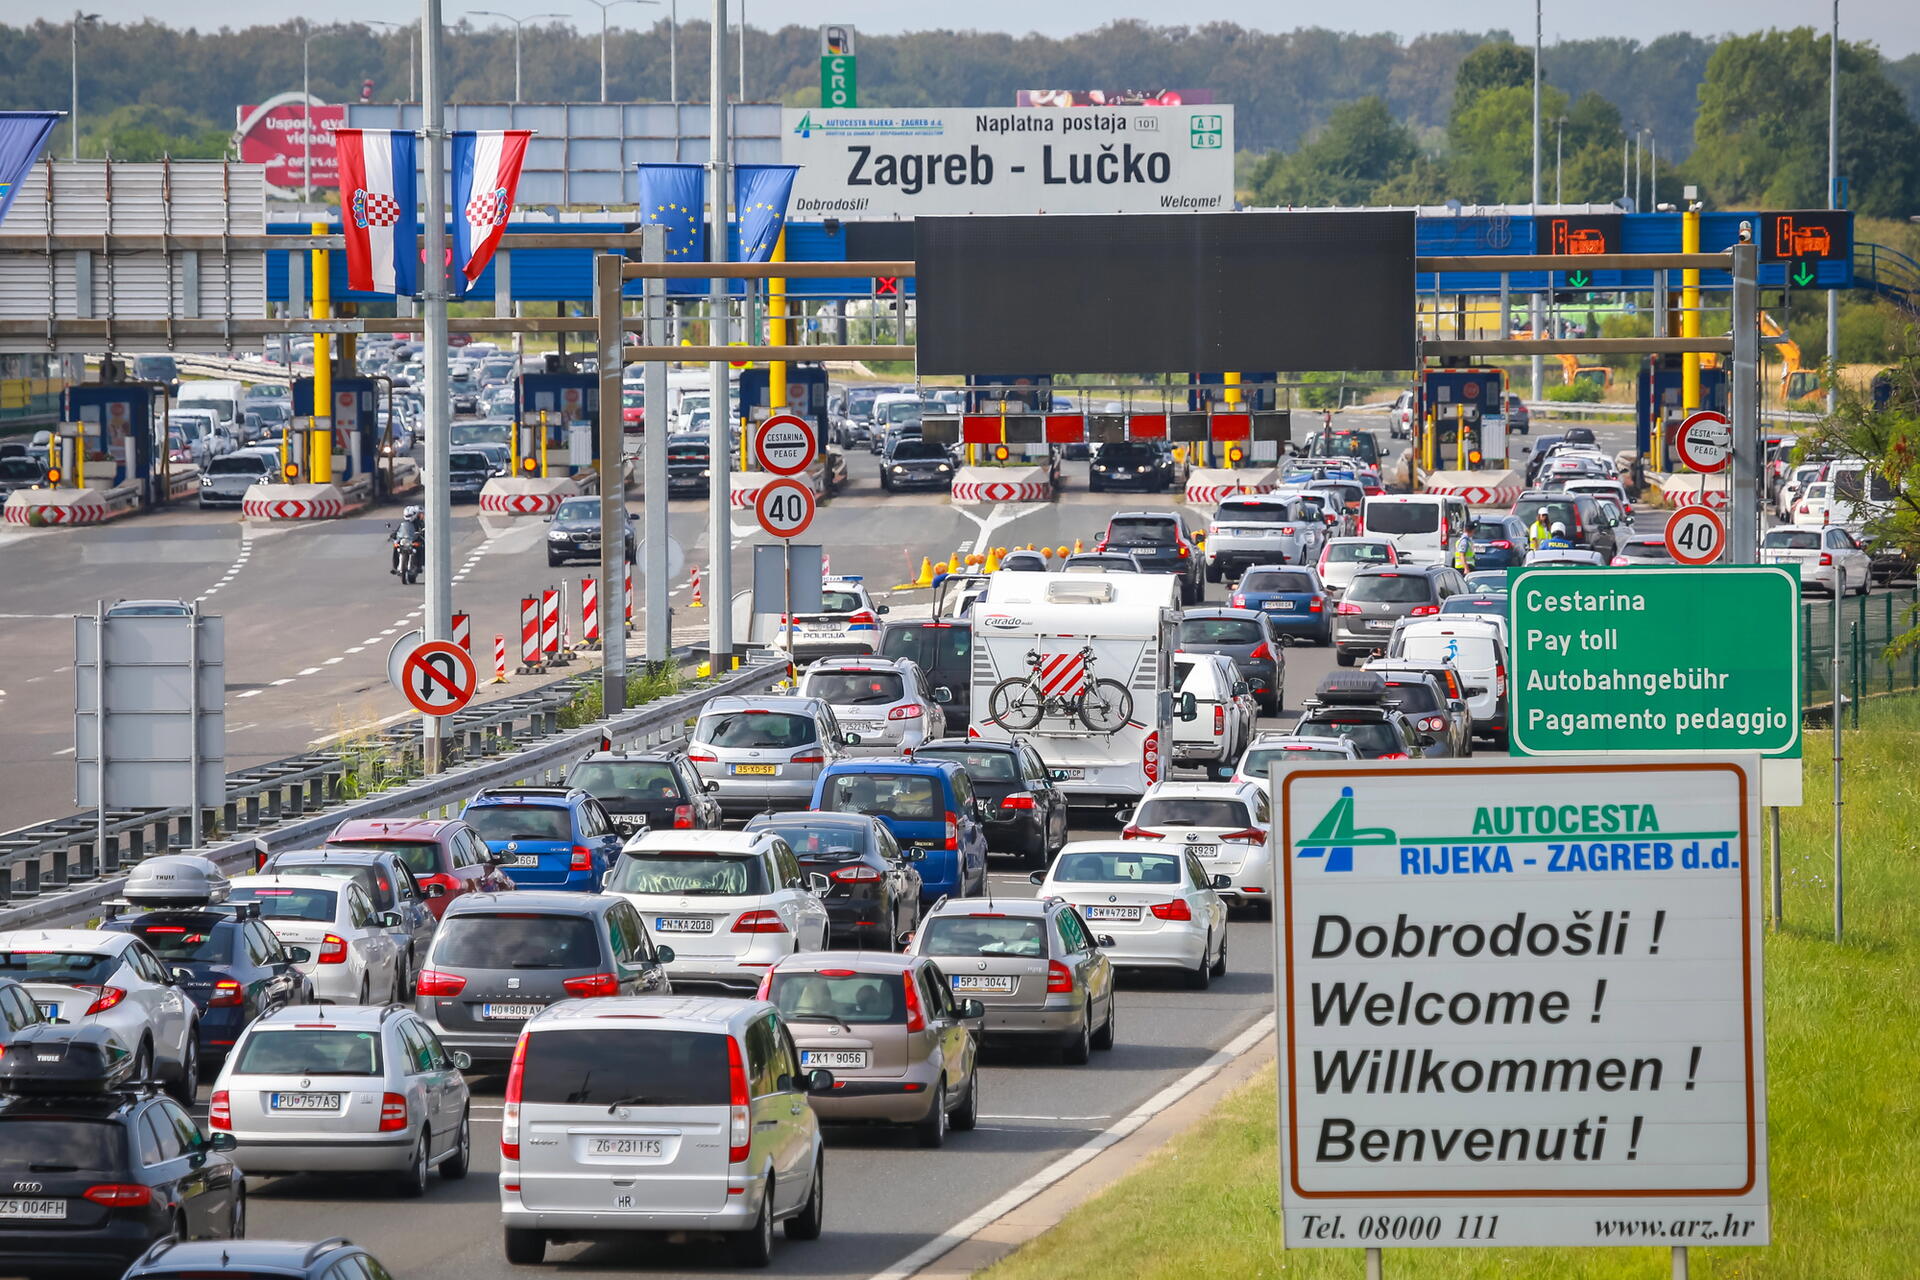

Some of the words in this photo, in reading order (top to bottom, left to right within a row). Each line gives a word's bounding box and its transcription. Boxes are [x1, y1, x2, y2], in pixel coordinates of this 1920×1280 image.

[976, 115, 1054, 135] Naplatna
[1063, 113, 1127, 134] postaja
[1138, 119, 1155, 128] 101
[847, 144, 994, 195] Zagreb
[1043, 143, 1171, 185] Lučko
[796, 197, 869, 211] Dobrodošli!
[1160, 195, 1222, 208] Welcome!
[767, 433, 804, 442] CESTARINA
[774, 449, 798, 458] PEAGE
[768, 494, 802, 522] 40
[1678, 522, 1712, 552] 40
[1526, 589, 1646, 612] Cestarina
[1527, 628, 1571, 656] Pay
[1579, 628, 1618, 650] toll
[1526, 667, 1729, 696] Autobahngebühr
[1528, 707, 1667, 736] Pagamento
[1675, 706, 1787, 736] pedaggio
[1471, 803, 1660, 836] AUTOCESTA
[1400, 845, 1514, 876] RIJEKA
[1547, 841, 1674, 873] ZAGREB
[1681, 840, 1740, 869] d.d.
[1311, 909, 1631, 960] Dobrodošli
[1310, 980, 1570, 1028] Welcome
[1312, 1047, 1664, 1095] Willkommen
[1315, 1115, 1608, 1164] Benvenuti
[618, 1195, 632, 1208] HR
[1302, 1215, 1346, 1241] Tel.
[1358, 1214, 1442, 1241] 08000
[1456, 1214, 1499, 1240] 111
[1594, 1213, 1755, 1242] www.arz.hr
